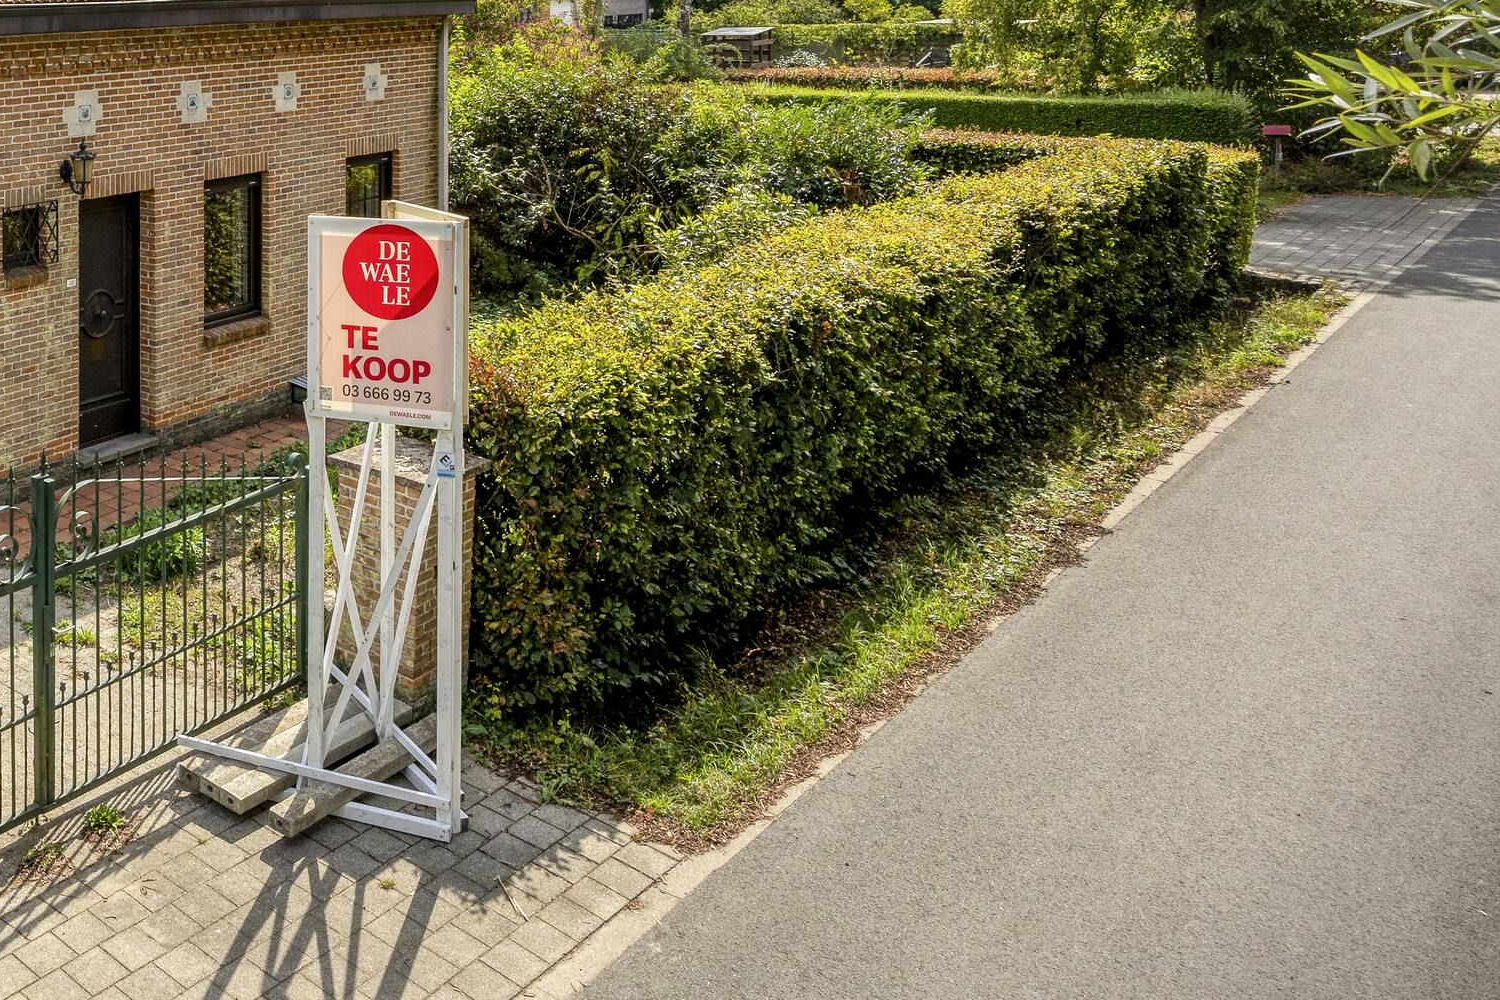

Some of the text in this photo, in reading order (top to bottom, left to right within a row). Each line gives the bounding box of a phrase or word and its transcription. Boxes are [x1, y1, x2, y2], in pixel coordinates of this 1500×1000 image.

[379, 241, 410, 262] DE
[360, 262, 410, 284] WAE
[382, 286, 410, 306] LE
[341, 324, 379, 350] TE
[342, 354, 431, 384] KOOP
[342, 384, 431, 404] 03 666 99 73
[389, 410, 431, 420] DEWAELE.COM
